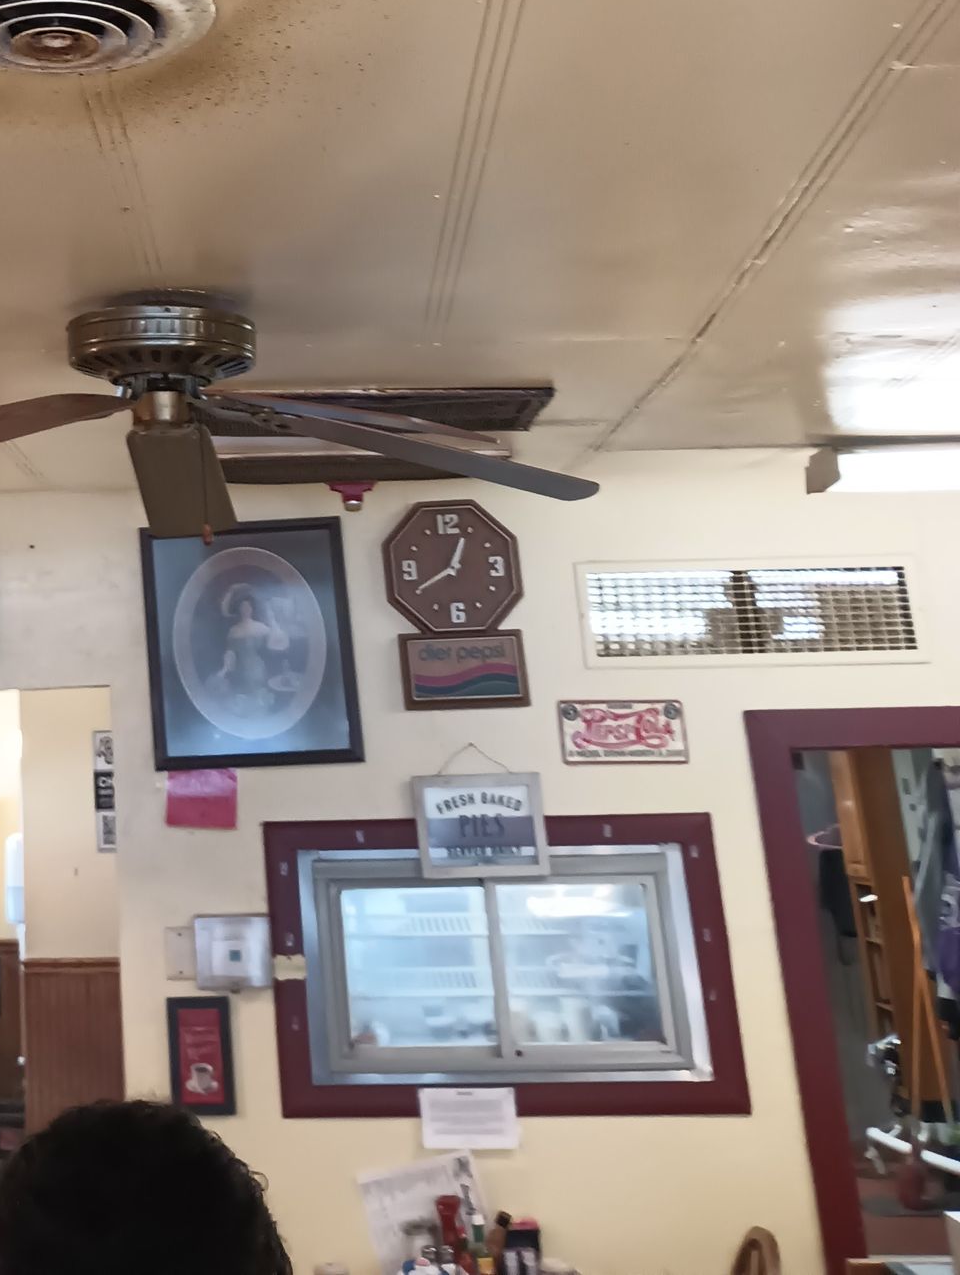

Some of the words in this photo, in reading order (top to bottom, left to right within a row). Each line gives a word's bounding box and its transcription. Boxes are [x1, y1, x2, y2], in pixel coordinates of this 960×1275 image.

[436, 514, 460, 534] 12
[402, 560, 418, 580] 9
[488, 556, 505, 576] 3
[450, 602, 466, 623] 6
[419, 644, 451, 661] diet
[456, 643, 505, 663] pepsi
[436, 792, 475, 814] FRESH
[481, 791, 522, 811] BAKED
[459, 813, 505, 838] PIES
